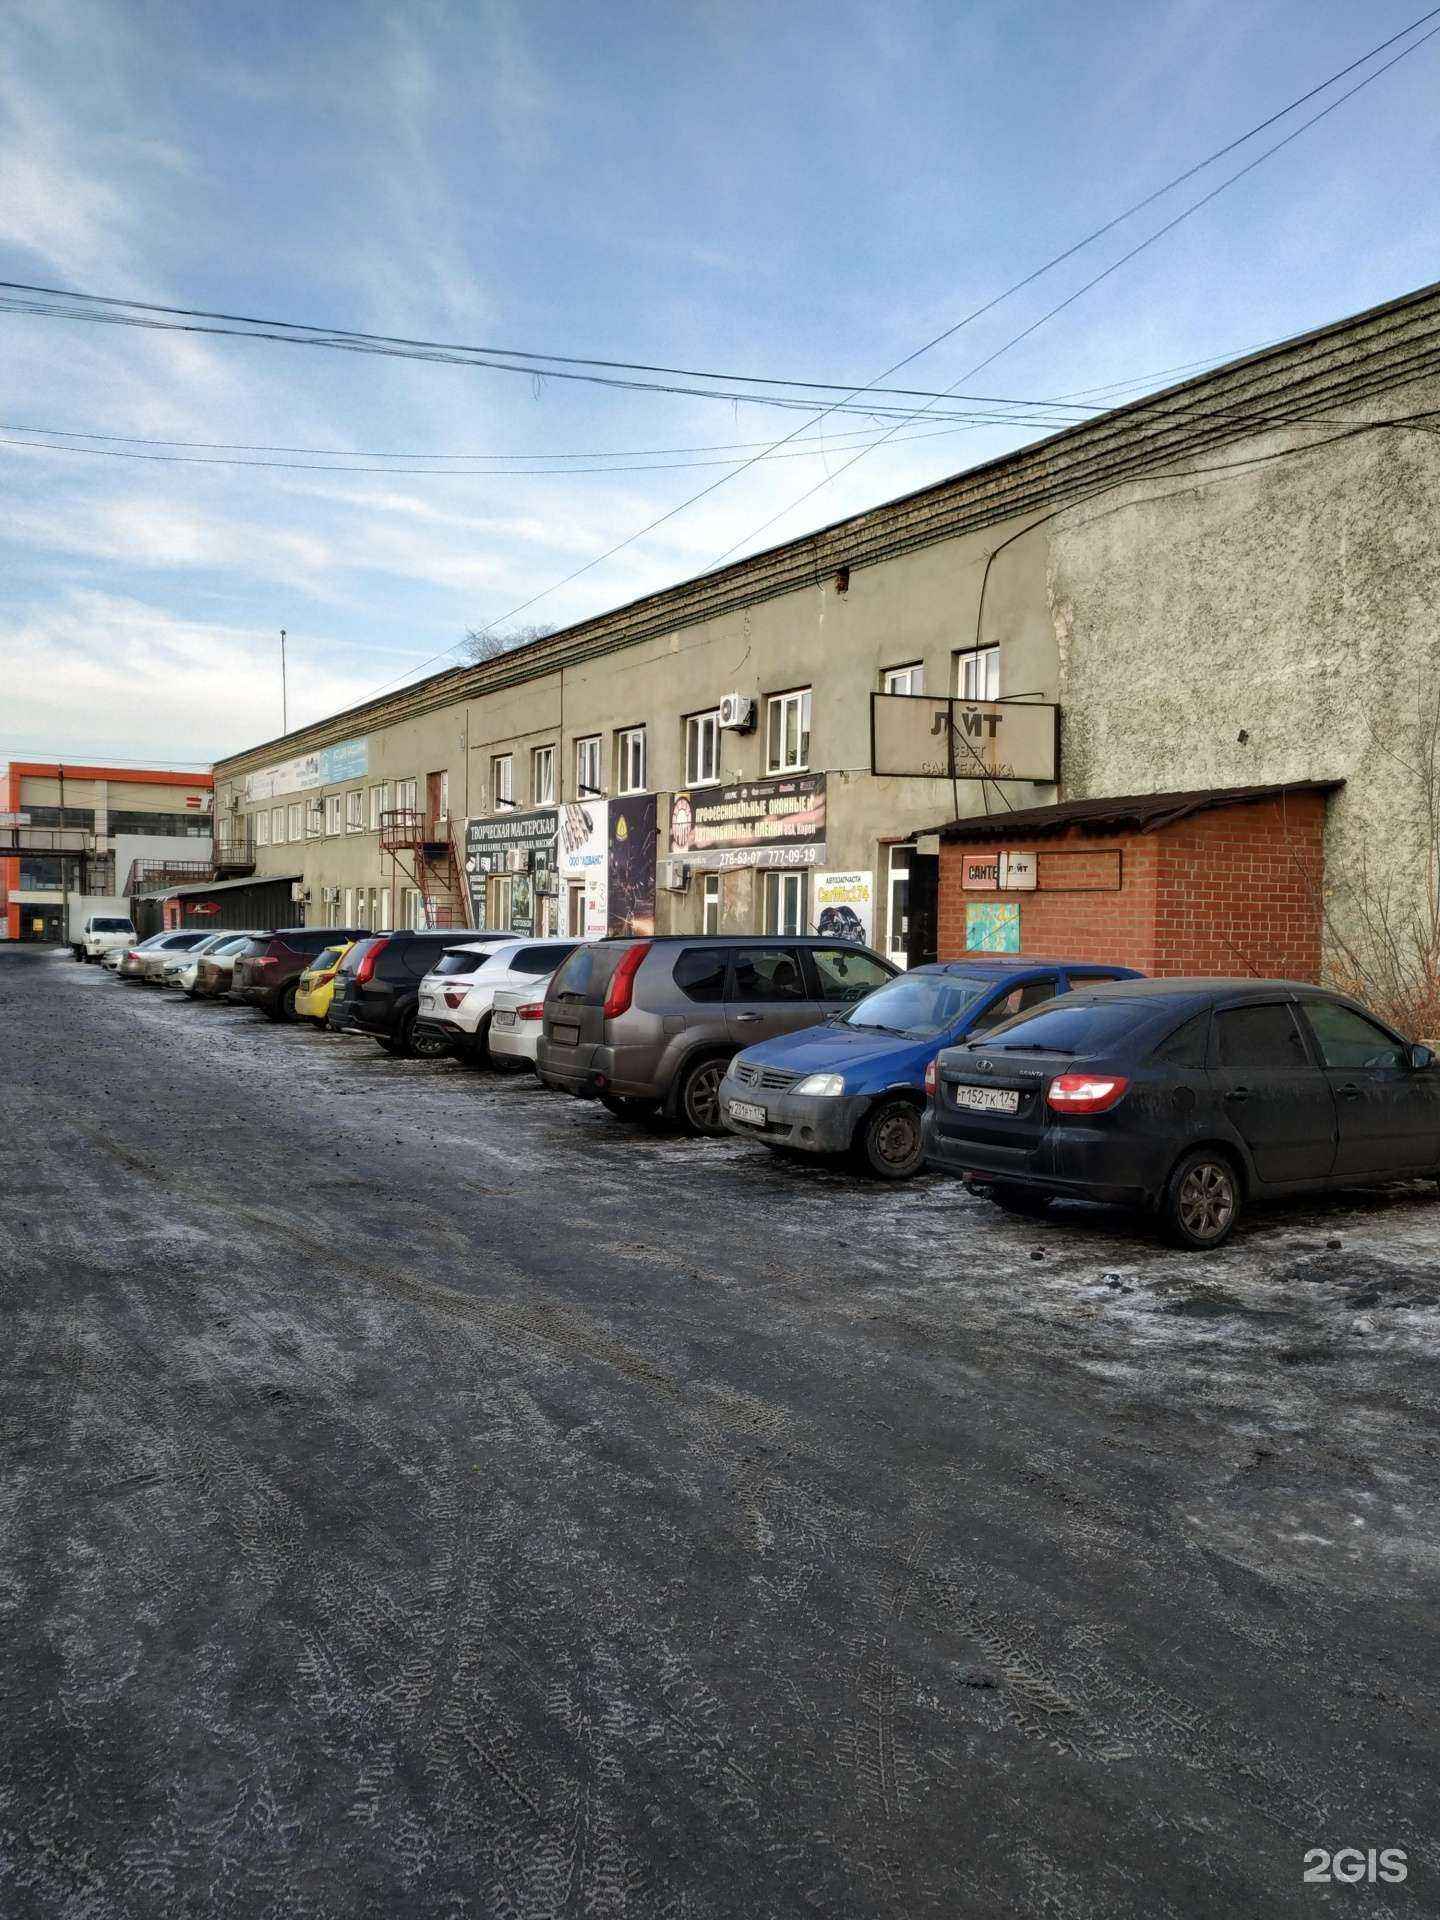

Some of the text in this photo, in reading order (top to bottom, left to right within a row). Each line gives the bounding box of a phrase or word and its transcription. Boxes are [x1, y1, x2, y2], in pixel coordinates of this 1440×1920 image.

[930, 706, 1003, 737] ЛЙТ
[695, 800, 767, 823] ПРОФЕССИОНАЛЬНЫЕ
[768, 796, 806, 816] ОКОННЫЕ
[471, 818, 555, 840] ТВОРЧЕСКАЯ МАСТЕРСКАЯ
[768, 848, 816, 864] 777-09-19
